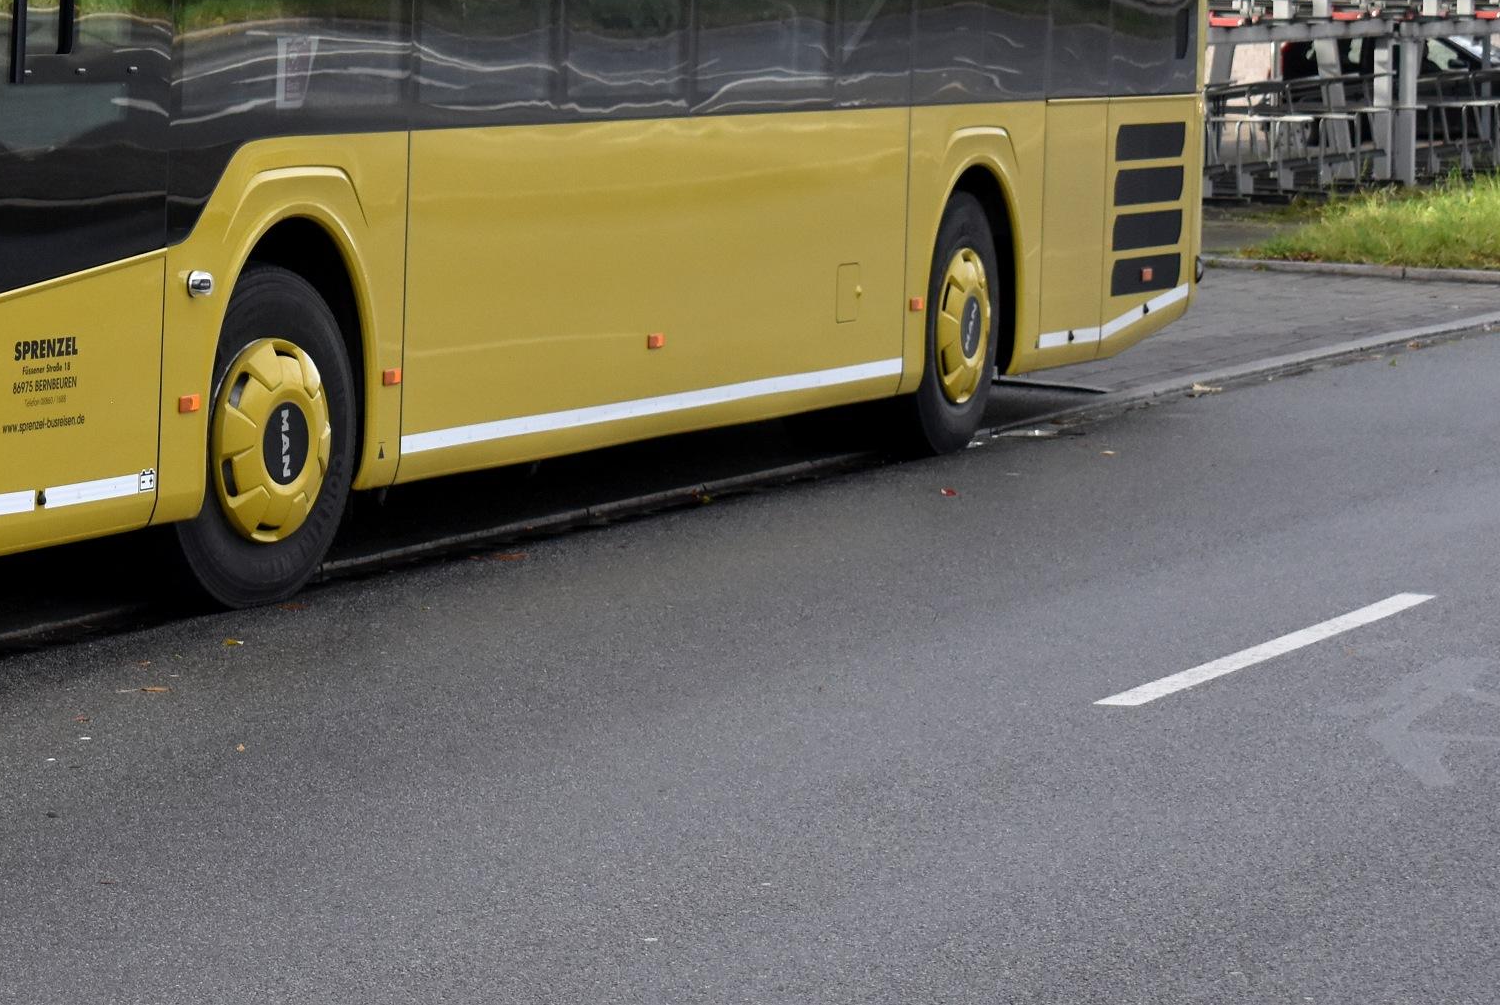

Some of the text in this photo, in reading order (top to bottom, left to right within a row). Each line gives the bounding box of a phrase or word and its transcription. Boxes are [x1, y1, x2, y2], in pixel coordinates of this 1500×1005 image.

[14, 336, 78, 361] SPRENZEL
[22, 364, 45, 375] Füssener
[46, 362, 62, 373] Straße
[12, 376, 77, 395] 86975 BERNBEUREN
[2, 413, 85, 434] www.sprenzel-busreisen.de
[281, 408, 291, 478] MAN
